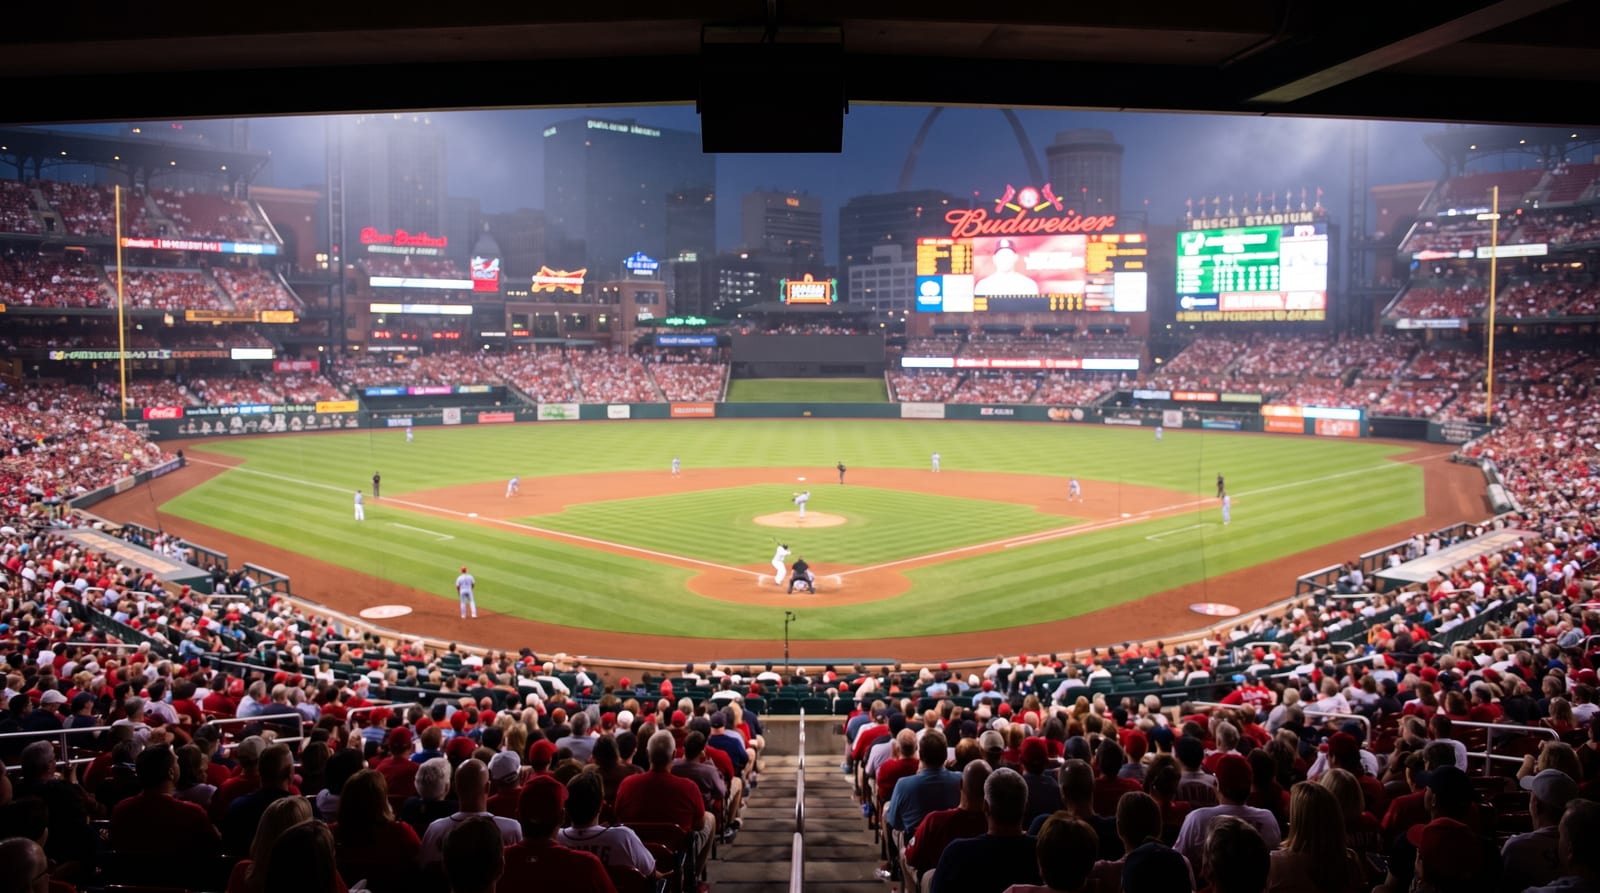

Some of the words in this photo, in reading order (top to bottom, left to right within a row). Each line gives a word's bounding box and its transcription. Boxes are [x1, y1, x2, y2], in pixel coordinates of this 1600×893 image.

[945, 208, 1115, 238] Budweiser
[1193, 217, 1239, 230] BUSCH
[1245, 212, 1313, 226] STADIUM
